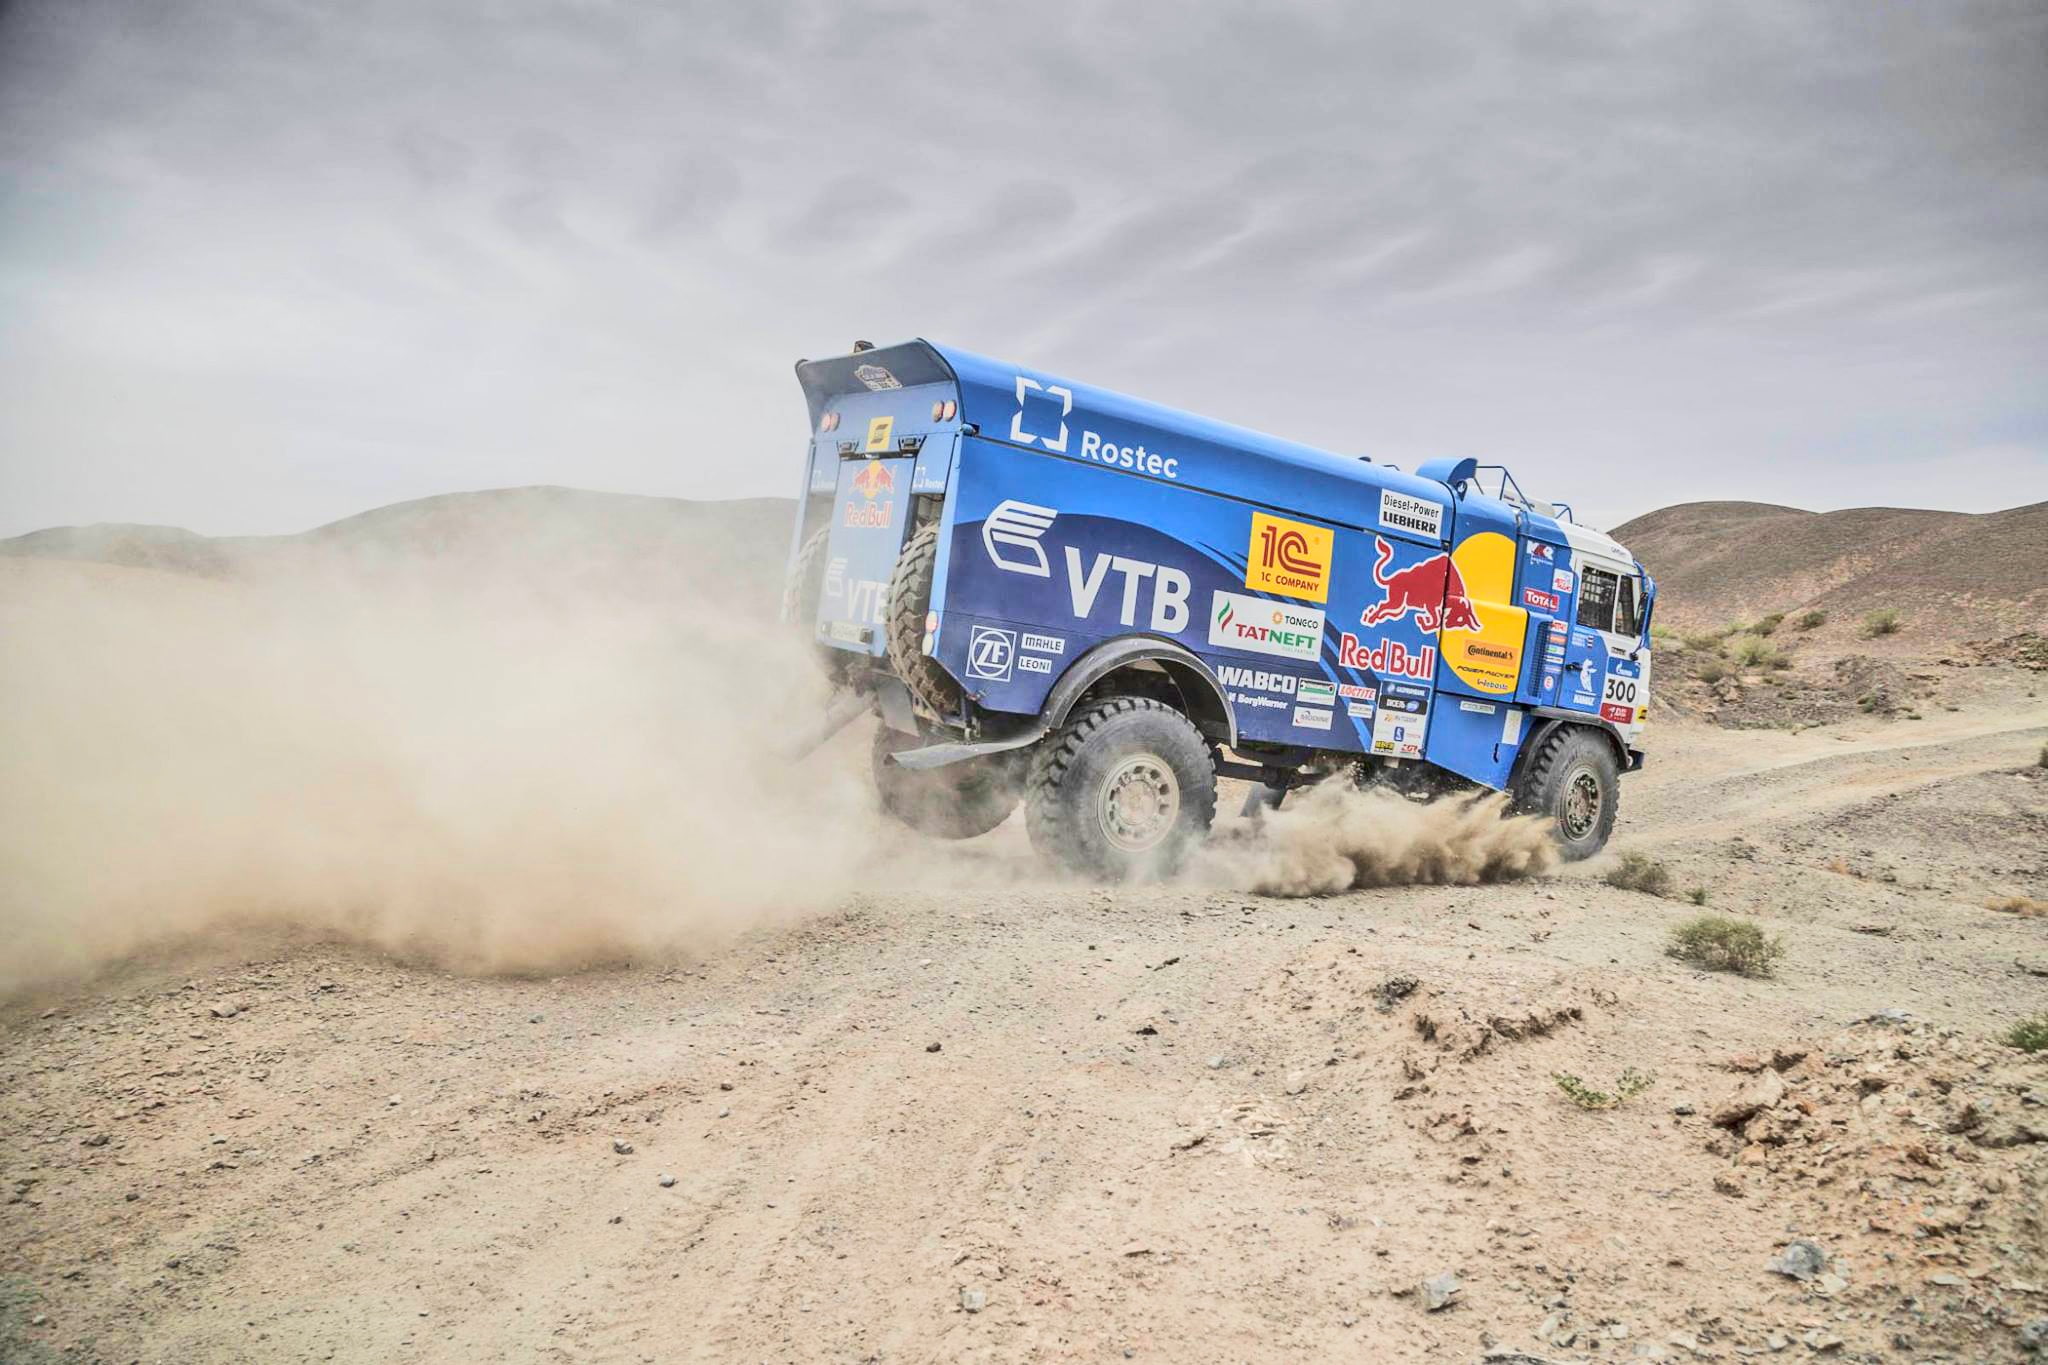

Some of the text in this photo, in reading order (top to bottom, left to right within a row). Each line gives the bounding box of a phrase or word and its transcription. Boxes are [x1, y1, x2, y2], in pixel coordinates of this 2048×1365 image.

[1081, 430, 1179, 479] Rostec
[1384, 494, 1439, 518] Diesel-Power
[1383, 511, 1437, 534] LIEBHERR
[1064, 545, 1191, 634] VTB
[1275, 575, 1319, 592] COMPANY
[1525, 589, 1557, 609] TOTAL
[1025, 636, 1062, 651] MAHLE
[1235, 623, 1316, 649] TATNEFT
[976, 638, 1009, 668] ZF
[1467, 644, 1508, 660] Continental
[1020, 658, 1050, 671] LEONI
[1217, 665, 1297, 694] WABCO
[1605, 679, 1636, 703] 300
[1238, 693, 1288, 709] BorgWarner
[1339, 685, 1374, 699] LOCTITE
